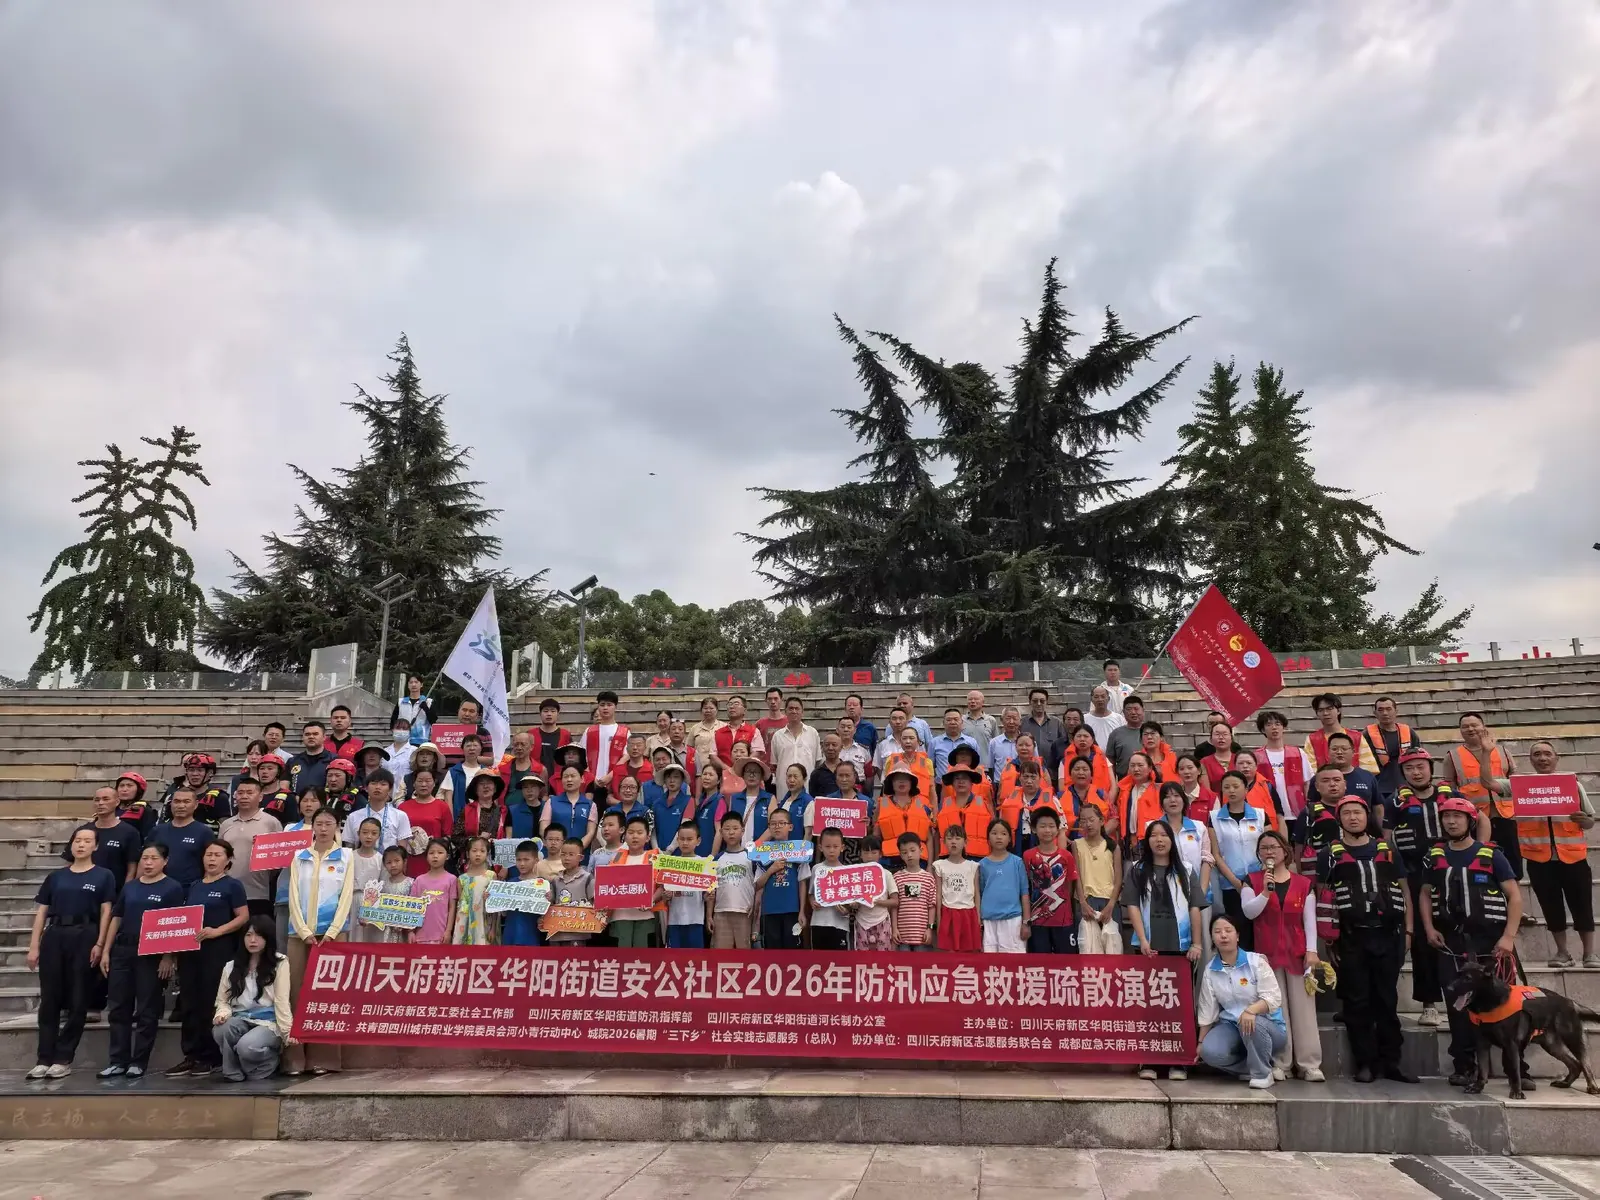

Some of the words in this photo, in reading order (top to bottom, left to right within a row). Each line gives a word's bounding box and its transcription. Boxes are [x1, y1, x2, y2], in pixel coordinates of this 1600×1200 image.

[820, 806, 861, 819] 微网前哨
[825, 817, 854, 829] 侦察队
[827, 870, 874, 887] 扎根基层
[598, 883, 649, 896] 同心志愿队
[825, 883, 877, 900] 青春建功
[311, 953, 1181, 1010] 四川天府新区华阳街道安公社区2026年防汛应急救援疏散演练
[528, 1007, 694, 1025] 四川天府新区华阳街道防汛指挥部
[706, 1011, 887, 1028] 四川天府新区华阳街道河长制办公室
[1057, 1038, 1185, 1054] 成都应急天府吊车救援队
